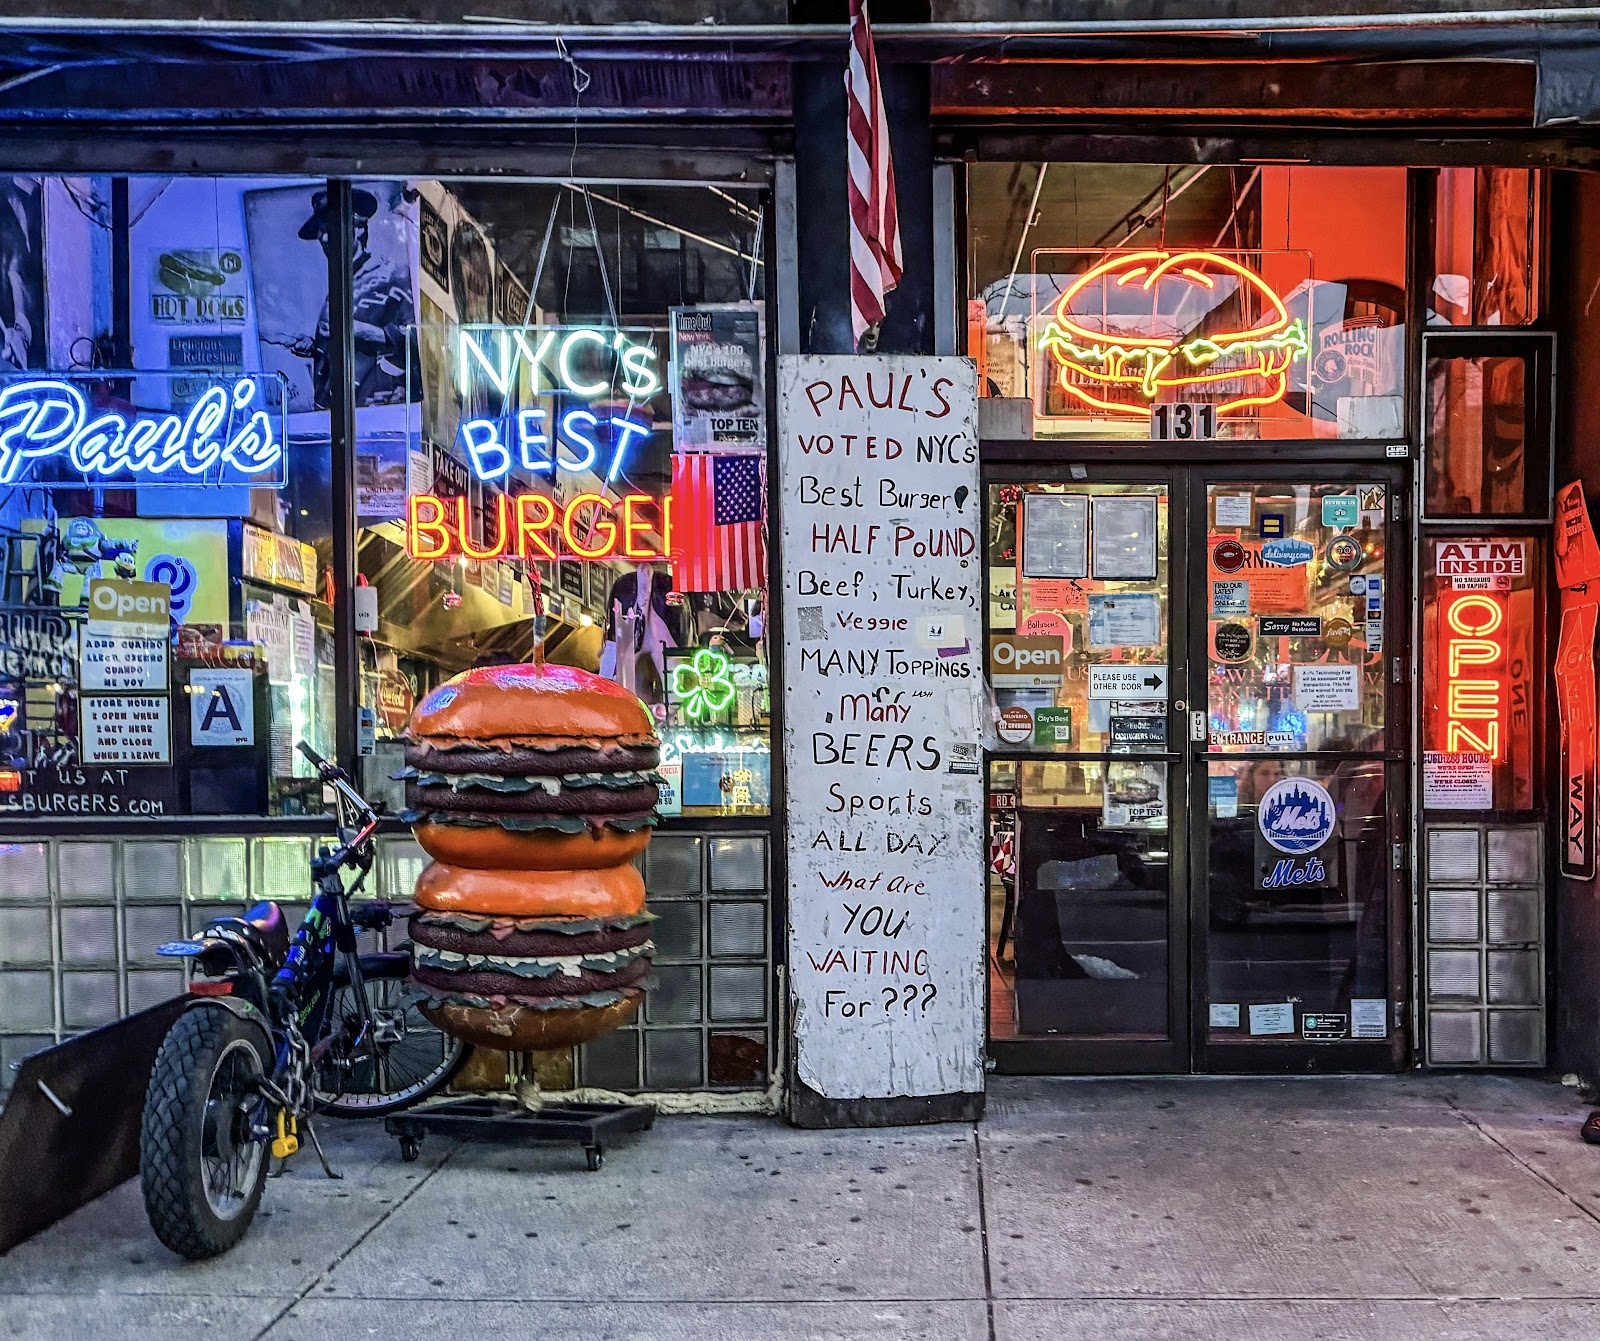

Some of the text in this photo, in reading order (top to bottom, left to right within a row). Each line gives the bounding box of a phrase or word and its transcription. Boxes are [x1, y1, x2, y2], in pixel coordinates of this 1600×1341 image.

[154, 298, 244, 316] HOT DOGS
[172, 338, 224, 350] Delicious
[678, 333, 711, 342] New York
[1324, 326, 1375, 348] ROLLING
[690, 344, 744, 356] NYC's 100
[1344, 344, 1374, 358] ROCK
[459, 329, 657, 396] NYC's
[684, 356, 751, 370] best burgers
[804, 368, 954, 418] PAUL'S
[0, 378, 283, 483] Paul's
[710, 418, 759, 430] TOP TEN
[1154, 405, 1214, 439] 131
[462, 408, 650, 480] BEST
[798, 432, 976, 464] VOTED NYC's
[435, 450, 454, 483] TAKE
[455, 466, 468, 491] OUT
[799, 475, 969, 514] Best Burger!
[811, 522, 881, 554] HALF
[1264, 548, 1311, 562] delivery.com
[1440, 544, 1522, 559] ATM
[1440, 561, 1522, 574] INSIDE
[798, 570, 878, 602] Beef,
[93, 586, 167, 618] Open
[250, 610, 289, 631] GOVERNMENT
[836, 610, 909, 631] Veggie
[1264, 621, 1290, 632] Sorry
[800, 648, 880, 678] MANY
[992, 642, 1060, 670] Open
[104, 666, 143, 675] CUANDO
[1448, 595, 1502, 759] OPEN
[123, 678, 144, 687] VOY
[1566, 646, 1584, 723] ONE
[90, 698, 160, 708] STORE HOURS
[200, 684, 243, 732] A
[92, 712, 159, 720] I OPEN WHEN
[104, 725, 124, 734] GET
[128, 725, 153, 734] HERE
[1210, 732, 1264, 744] ENTRANCE
[98, 737, 153, 746] AND CLOSE
[812, 732, 942, 772] BEERS
[93, 751, 119, 760] WHEN
[131, 751, 160, 760] LEAVE
[1462, 754, 1489, 764] HOURS
[58, 769, 128, 786] US AT
[826, 782, 933, 818] Sports
[1272, 805, 1321, 830] Mets
[1569, 774, 1584, 854] WAY
[812, 830, 948, 856] ALL DAY
[818, 871, 882, 892] What
[1263, 856, 1326, 888] Mets
[842, 902, 910, 940] YOU
[806, 948, 929, 976] WAITING
[824, 983, 938, 1019] For ???
